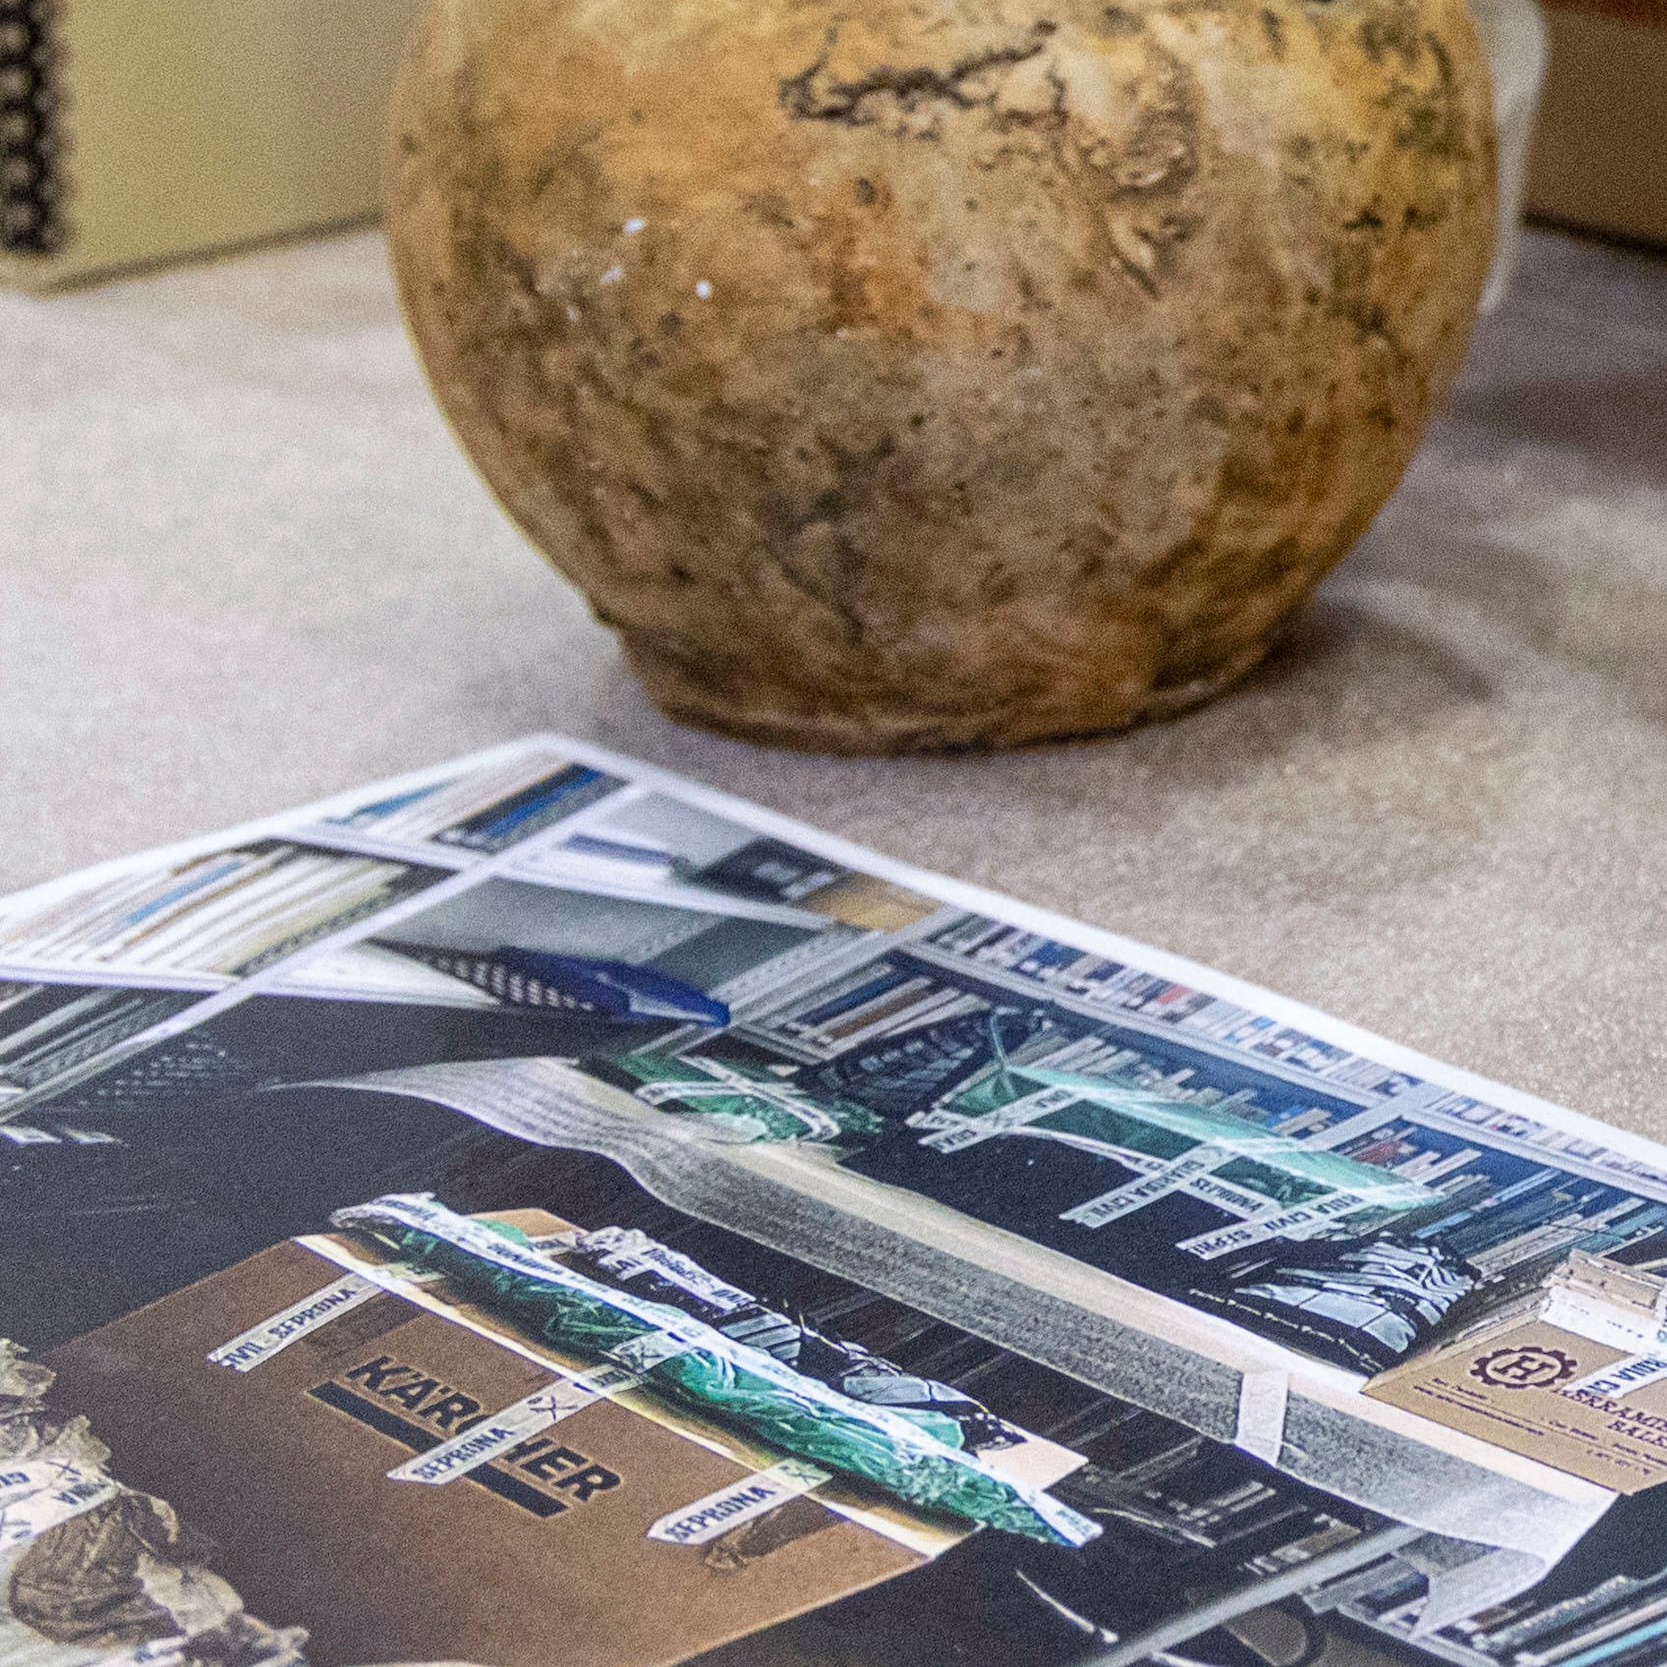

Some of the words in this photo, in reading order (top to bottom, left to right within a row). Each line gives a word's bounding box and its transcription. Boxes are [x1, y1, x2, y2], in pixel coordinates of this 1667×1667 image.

[268, 1287, 357, 1340] SEPRONA
[410, 1426, 518, 1480] SEPRONA
[664, 1485, 777, 1542] SEPRONA
